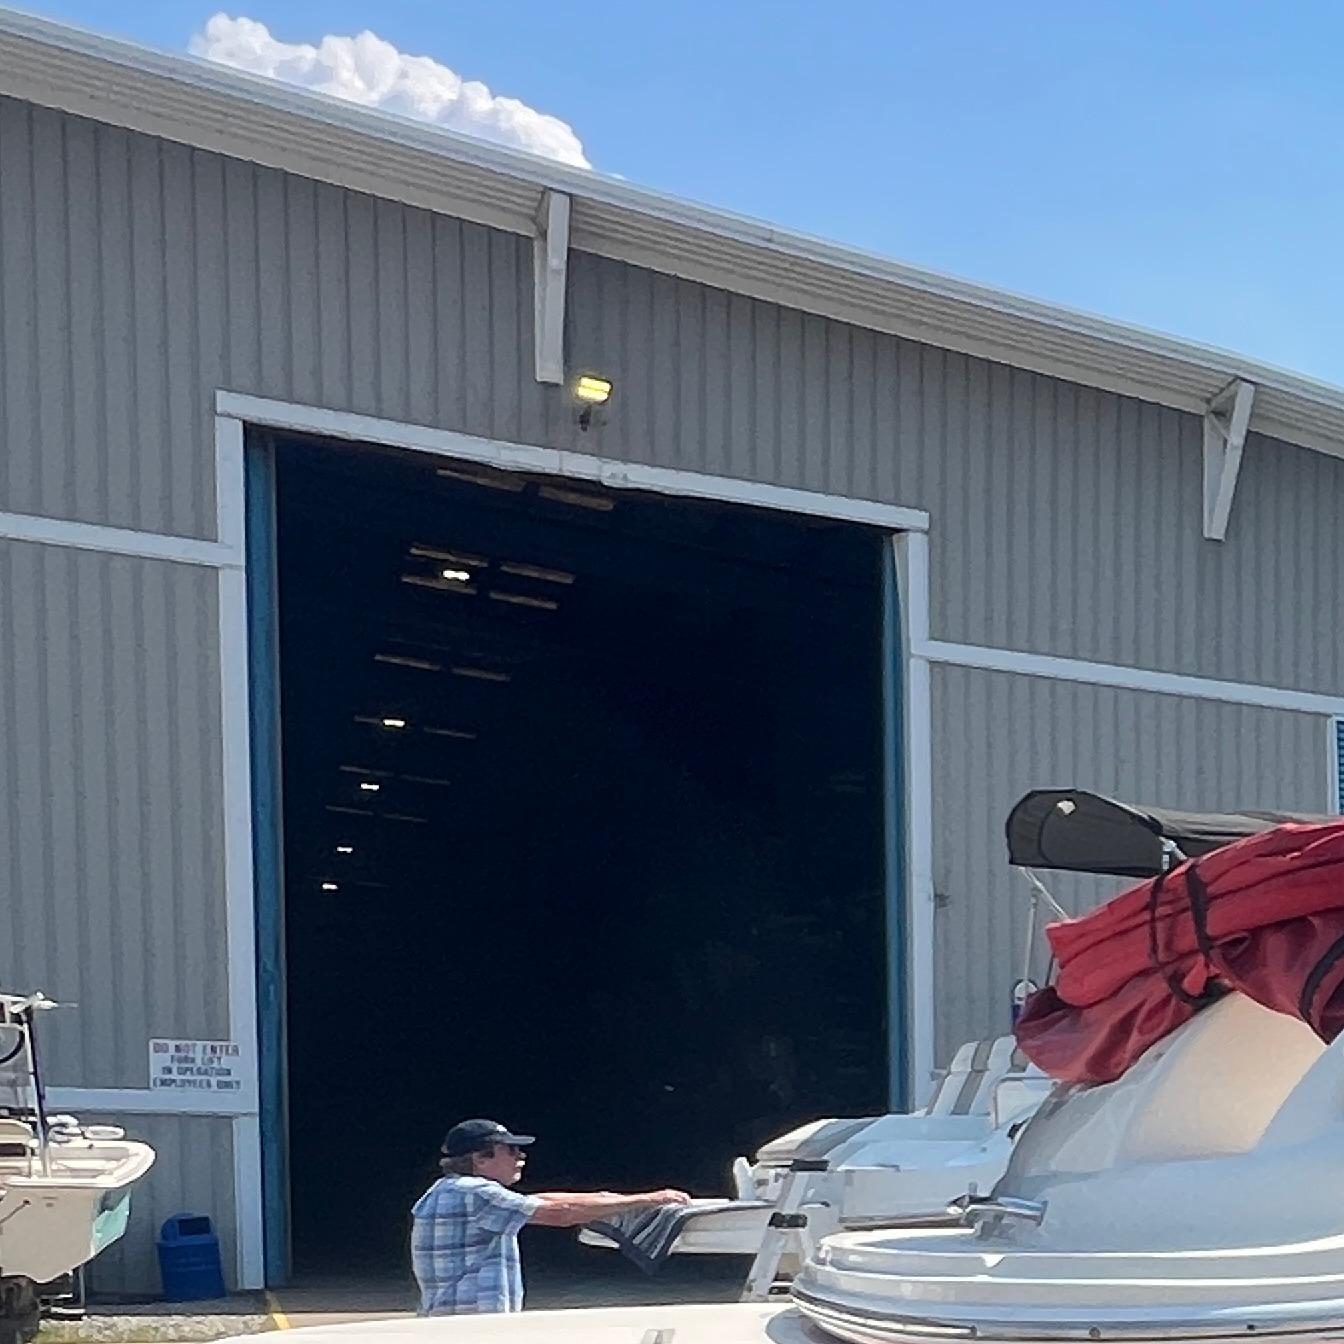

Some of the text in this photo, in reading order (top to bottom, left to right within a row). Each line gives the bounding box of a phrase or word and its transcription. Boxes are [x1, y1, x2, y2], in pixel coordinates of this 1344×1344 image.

[153, 1042, 240, 1057] DO NOT ENTER
[161, 1066, 232, 1076] IN OPERATION
[216, 1079, 241, 1090] ONLY
